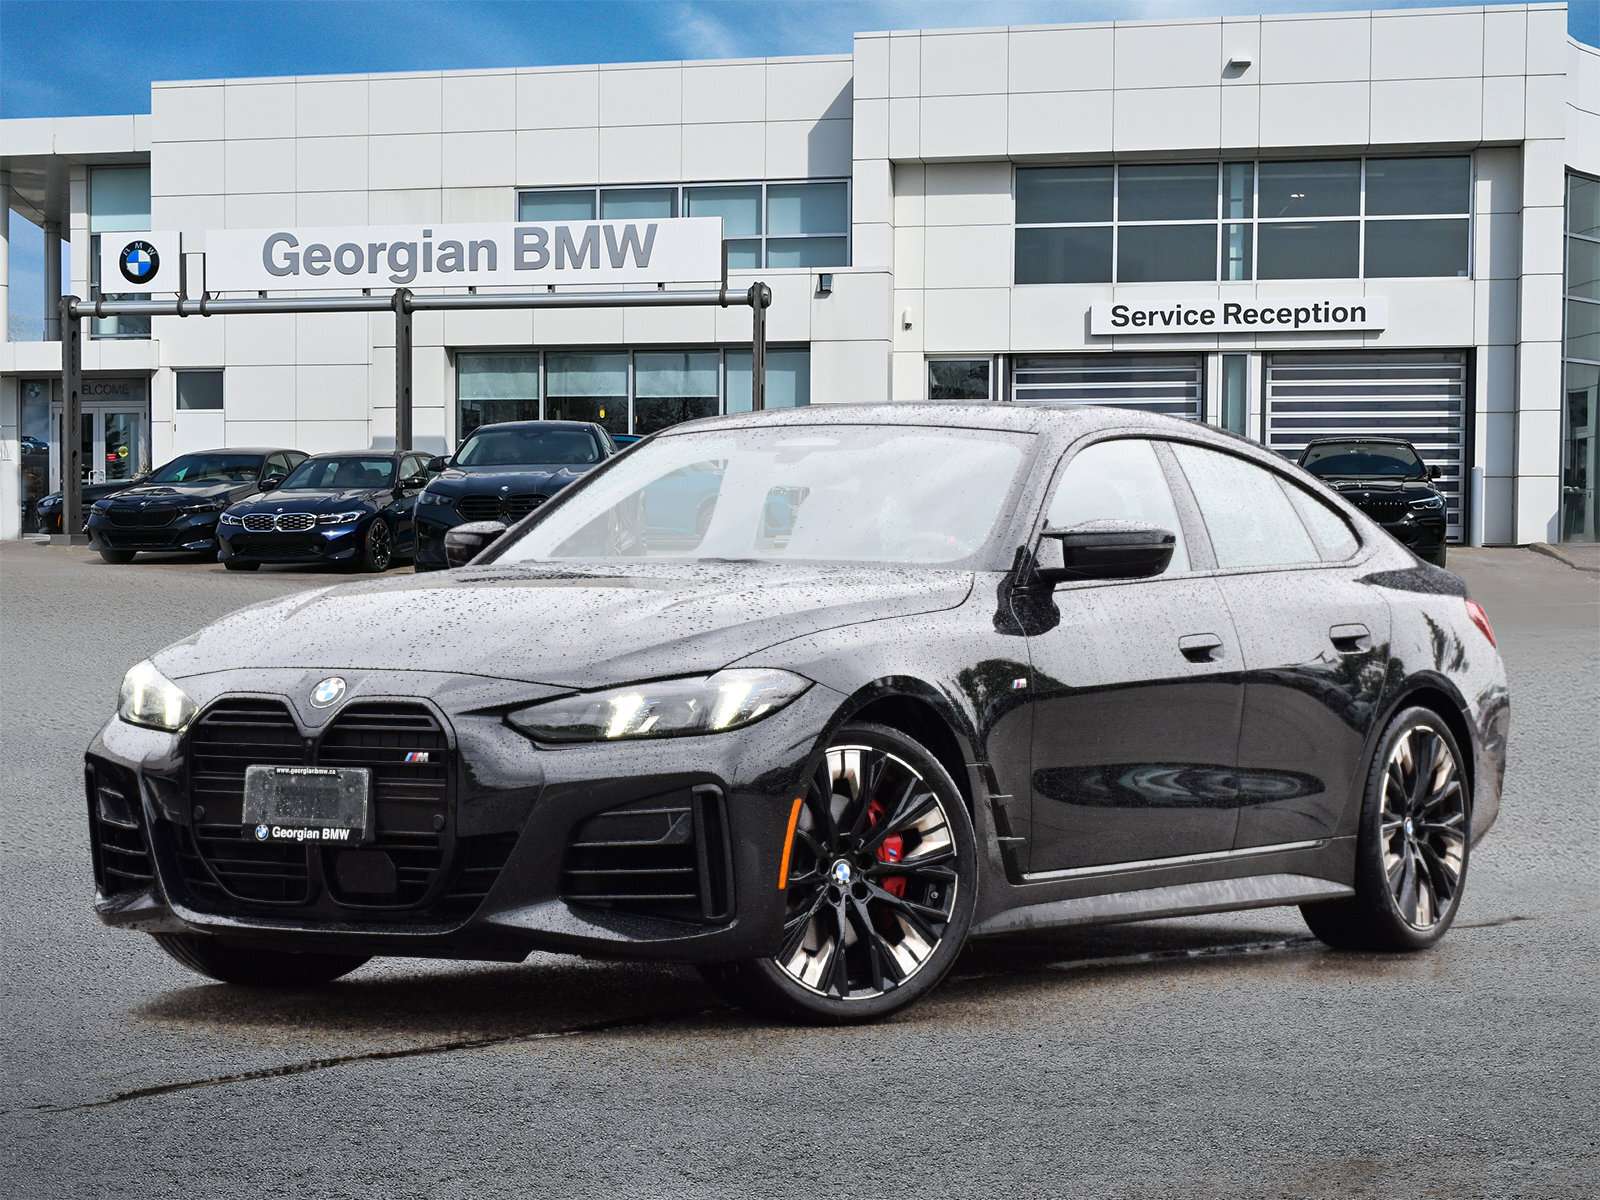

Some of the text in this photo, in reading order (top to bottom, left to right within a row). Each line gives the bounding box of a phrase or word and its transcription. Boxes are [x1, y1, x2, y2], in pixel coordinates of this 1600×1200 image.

[122, 242, 157, 256] BMW
[262, 223, 658, 284] Georgian BMW
[1111, 301, 1366, 328] Service Reception
[80, 383, 129, 395] ELCOME
[272, 826, 350, 841] Georgian BMW
